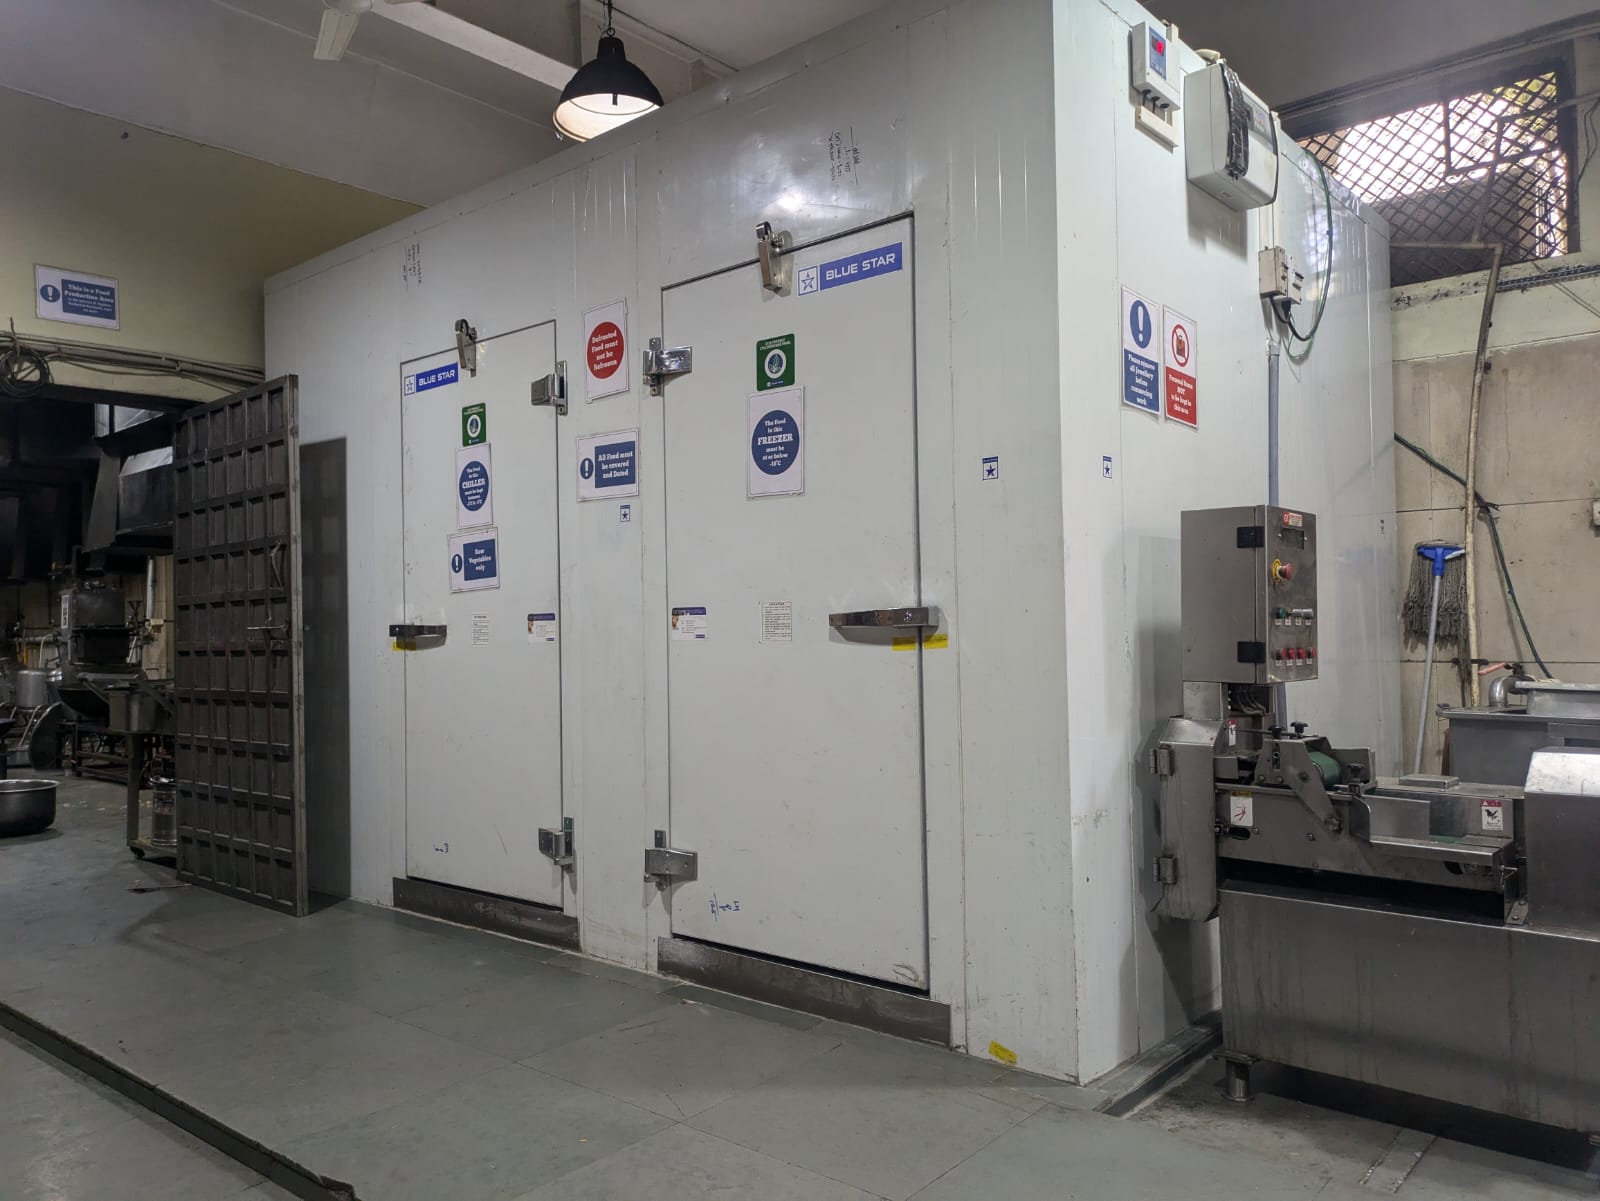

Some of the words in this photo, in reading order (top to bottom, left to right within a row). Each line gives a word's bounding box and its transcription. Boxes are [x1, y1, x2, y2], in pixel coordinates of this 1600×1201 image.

[826, 263, 858, 280] BLUE
[862, 253, 896, 271] STAR
[64, 290, 98, 300] Production
[592, 330, 617, 344] Defrosted
[592, 343, 604, 353] Food
[605, 340, 618, 349] must
[606, 350, 613, 358] be
[418, 374, 436, 386] BLUE
[437, 369, 455, 381] STAR
[1136, 376, 1148, 387] before
[1136, 397, 1147, 405] work
[757, 433, 793, 446] FREEZER
[598, 453, 606, 461] All
[606, 451, 619, 460] Food
[602, 462, 609, 470] be
[609, 460, 629, 469] covered
[603, 471, 612, 479] and
[613, 469, 629, 477] Dated
[462, 478, 485, 489] CHILLER
[468, 554, 491, 564] Vegetables
[475, 563, 485, 572] only
